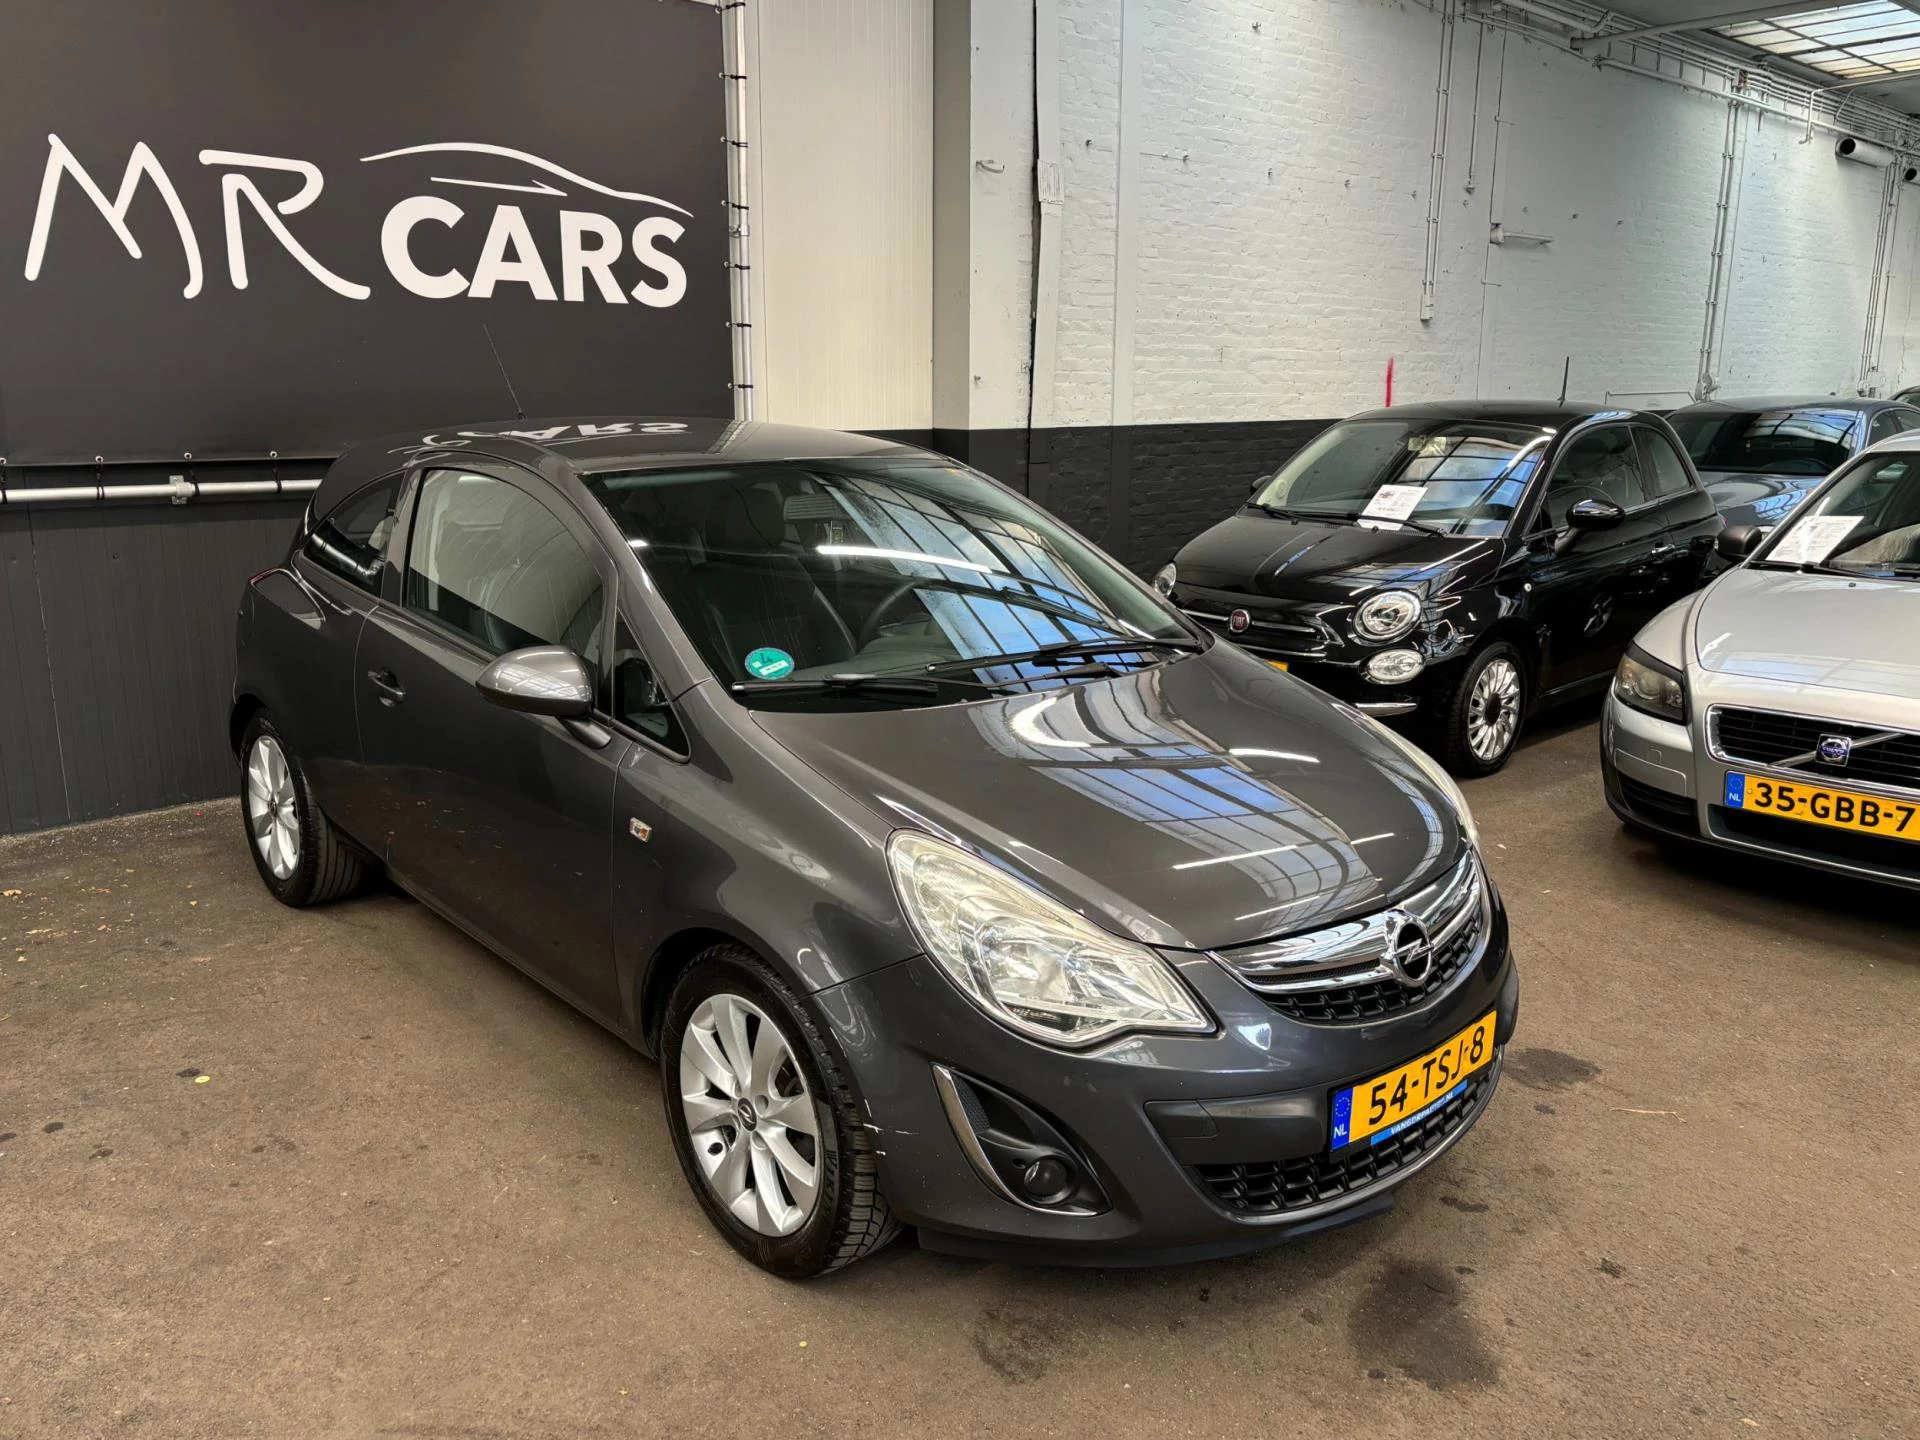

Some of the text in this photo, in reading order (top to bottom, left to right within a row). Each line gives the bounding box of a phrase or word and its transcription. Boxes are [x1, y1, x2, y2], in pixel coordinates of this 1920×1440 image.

[25, 133, 688, 309] MR CARS
[1729, 792, 1742, 802] NL
[1754, 782, 1916, 832] 35-GBB-7
[1368, 1025, 1485, 1126] 54-TSJ-8
[1333, 1123, 1348, 1139] NL
